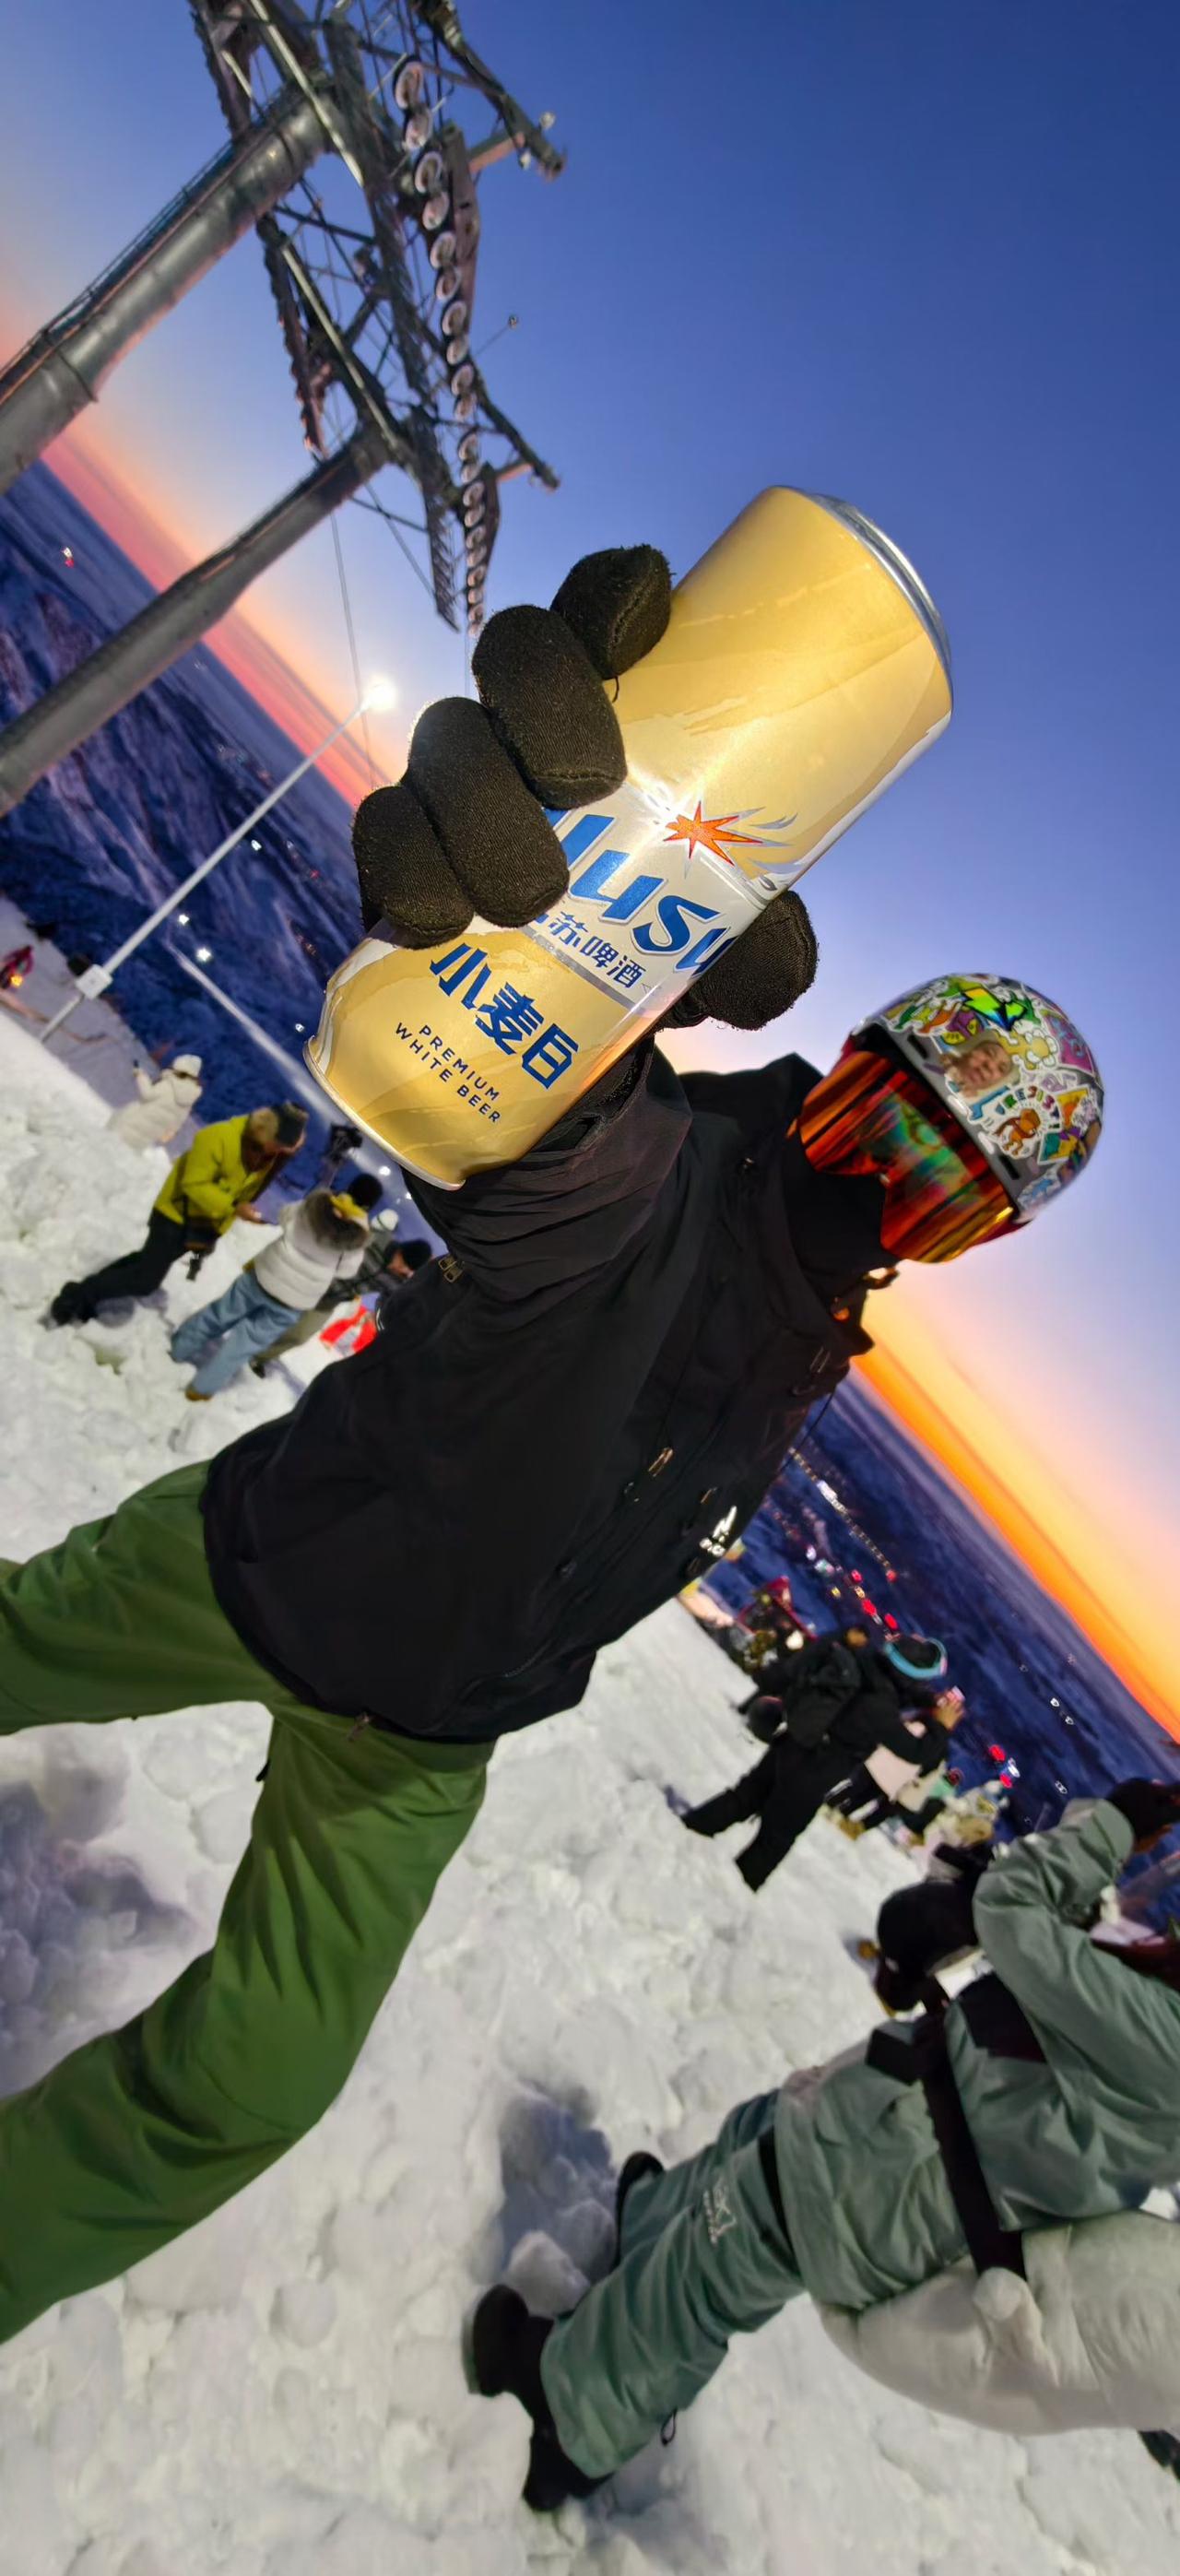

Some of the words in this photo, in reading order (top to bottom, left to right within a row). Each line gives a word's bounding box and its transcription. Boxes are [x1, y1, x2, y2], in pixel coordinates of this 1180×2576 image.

[534, 911, 646, 988] 苏啤酒
[430, 943, 579, 1089] 小麦白
[396, 1022, 453, 1083] WHITE
[456, 1084, 502, 1123] BEER
[419, 1024, 501, 1101] PREMIUM
